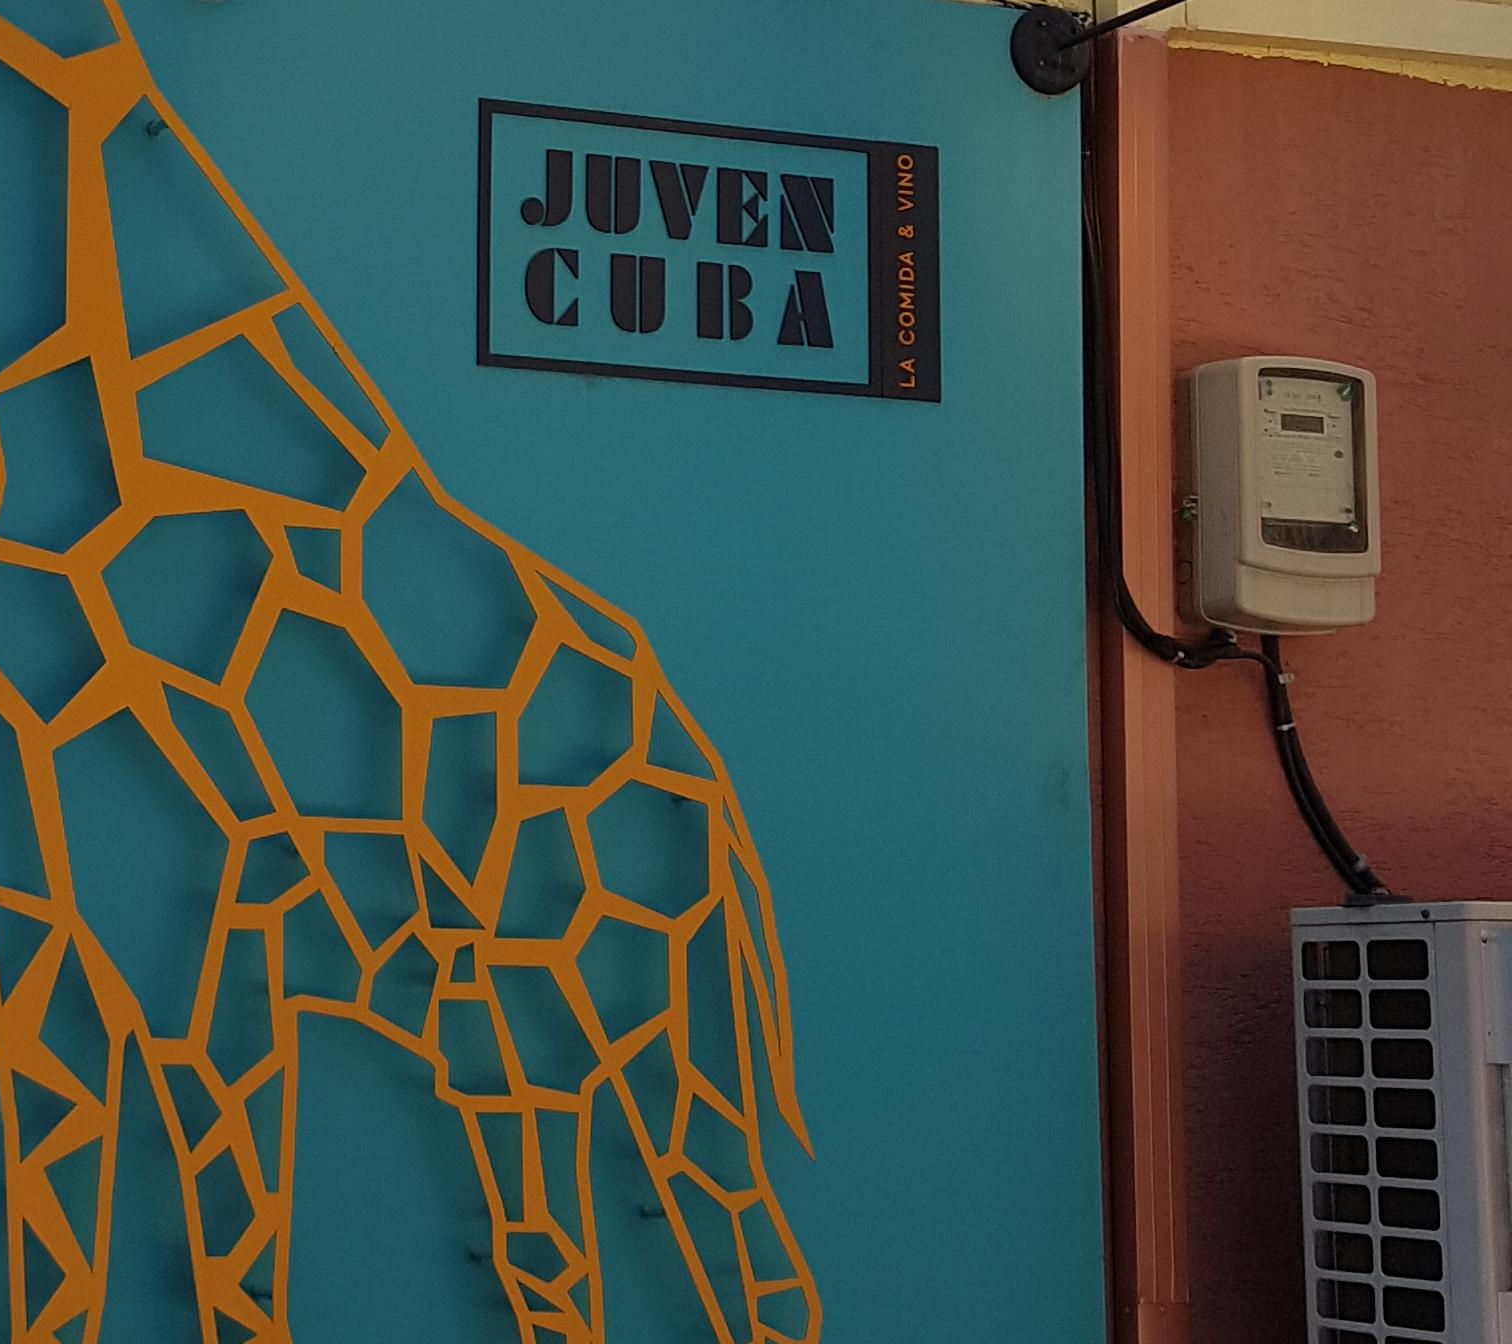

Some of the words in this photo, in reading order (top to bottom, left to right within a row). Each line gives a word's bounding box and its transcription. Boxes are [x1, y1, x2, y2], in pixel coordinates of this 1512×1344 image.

[520, 148, 835, 255] JUVEN
[897, 154, 916, 212] VINO
[898, 224, 915, 239] &
[524, 247, 835, 349] CUBA
[897, 251, 916, 346] COMIDA
[898, 358, 916, 388] LA
